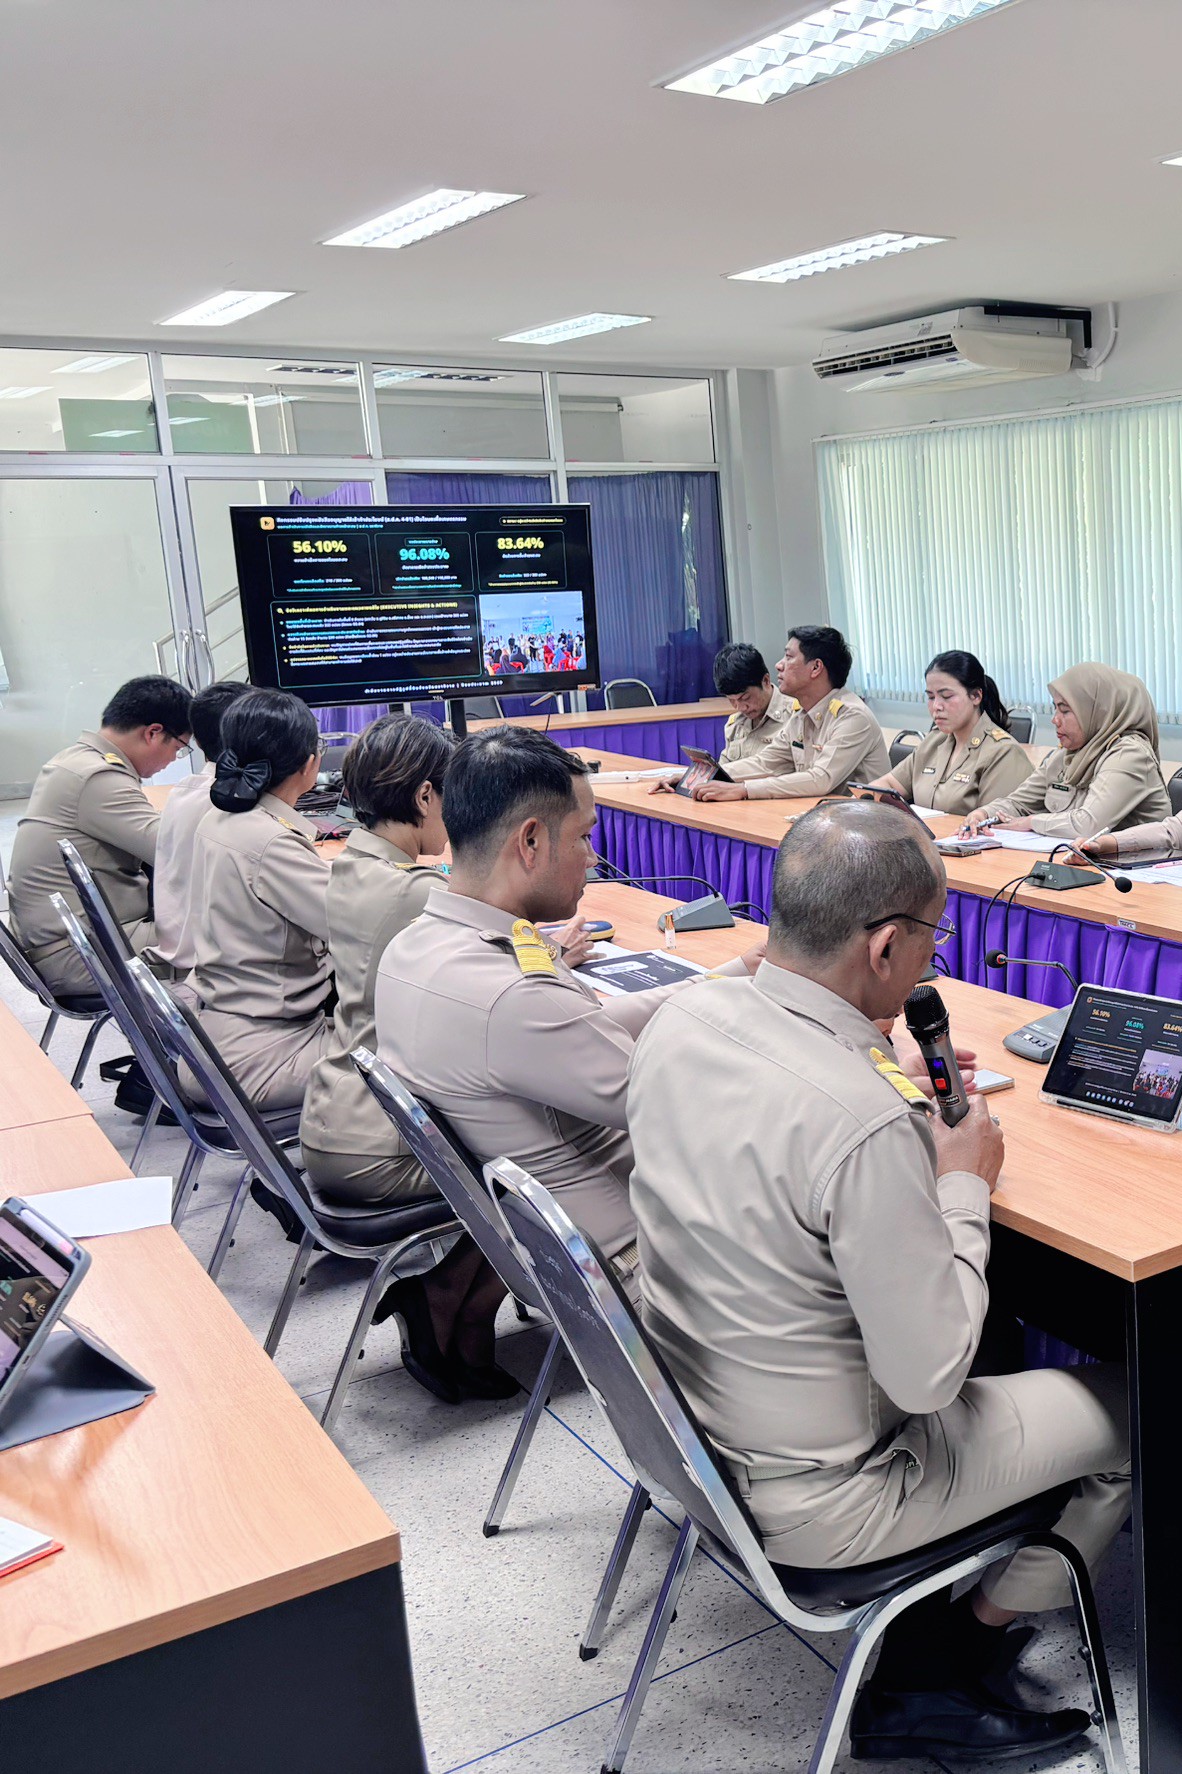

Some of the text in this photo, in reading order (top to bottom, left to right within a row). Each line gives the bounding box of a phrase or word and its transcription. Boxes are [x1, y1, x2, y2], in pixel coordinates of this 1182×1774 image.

[292, 540, 347, 553] 56.10%
[497, 537, 545, 550] 83.64%
[399, 548, 450, 560] 96.08%
